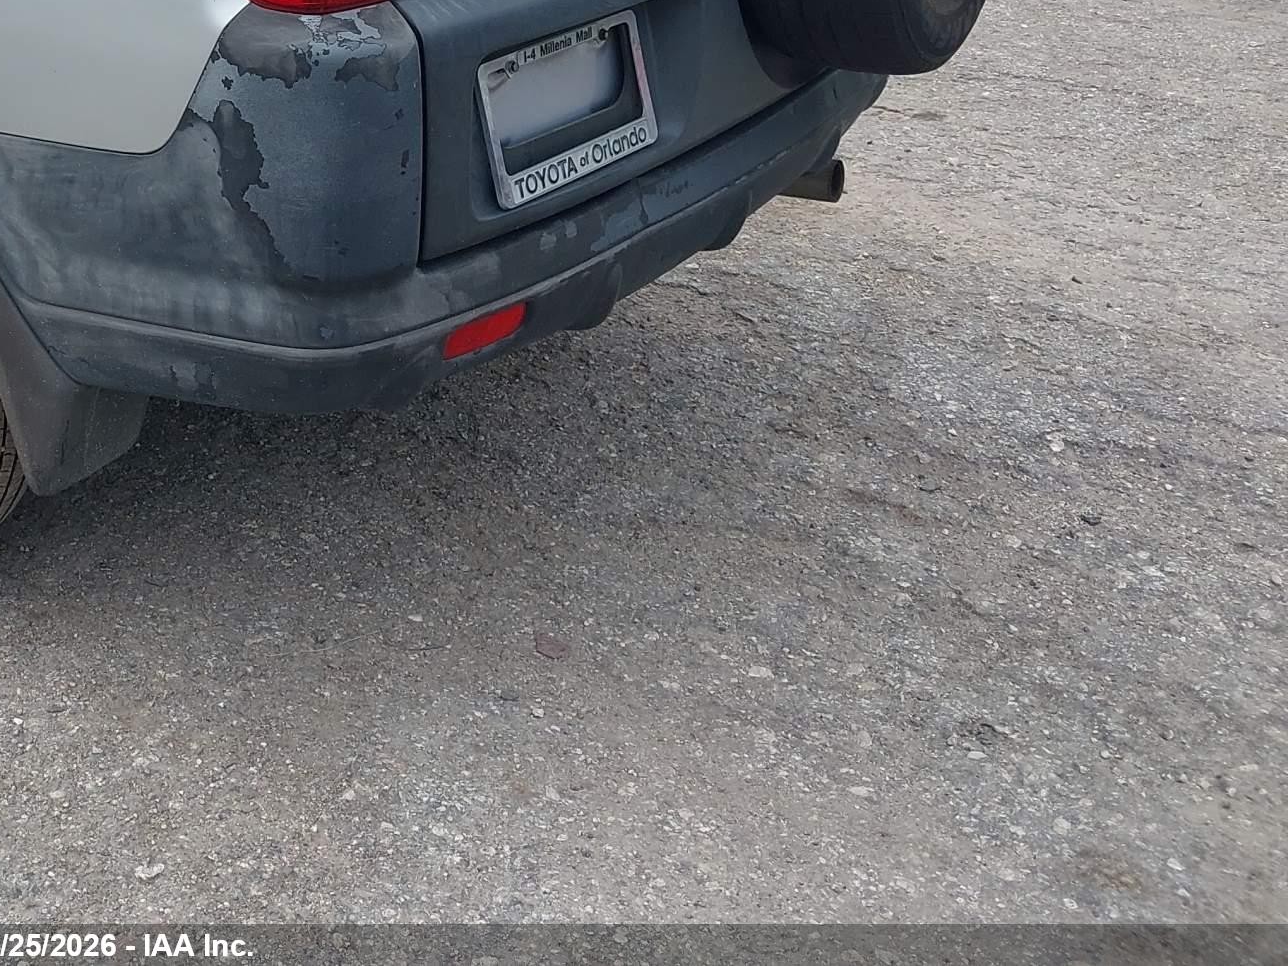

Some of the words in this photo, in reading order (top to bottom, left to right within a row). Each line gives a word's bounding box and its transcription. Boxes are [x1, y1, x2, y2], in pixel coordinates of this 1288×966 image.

[523, 49, 536, 64] I-4
[539, 35, 573, 58] Millenia
[575, 26, 593, 43] Mall
[514, 158, 578, 200] TOYOTA
[579, 151, 590, 167] of
[591, 125, 648, 164] Orlando
